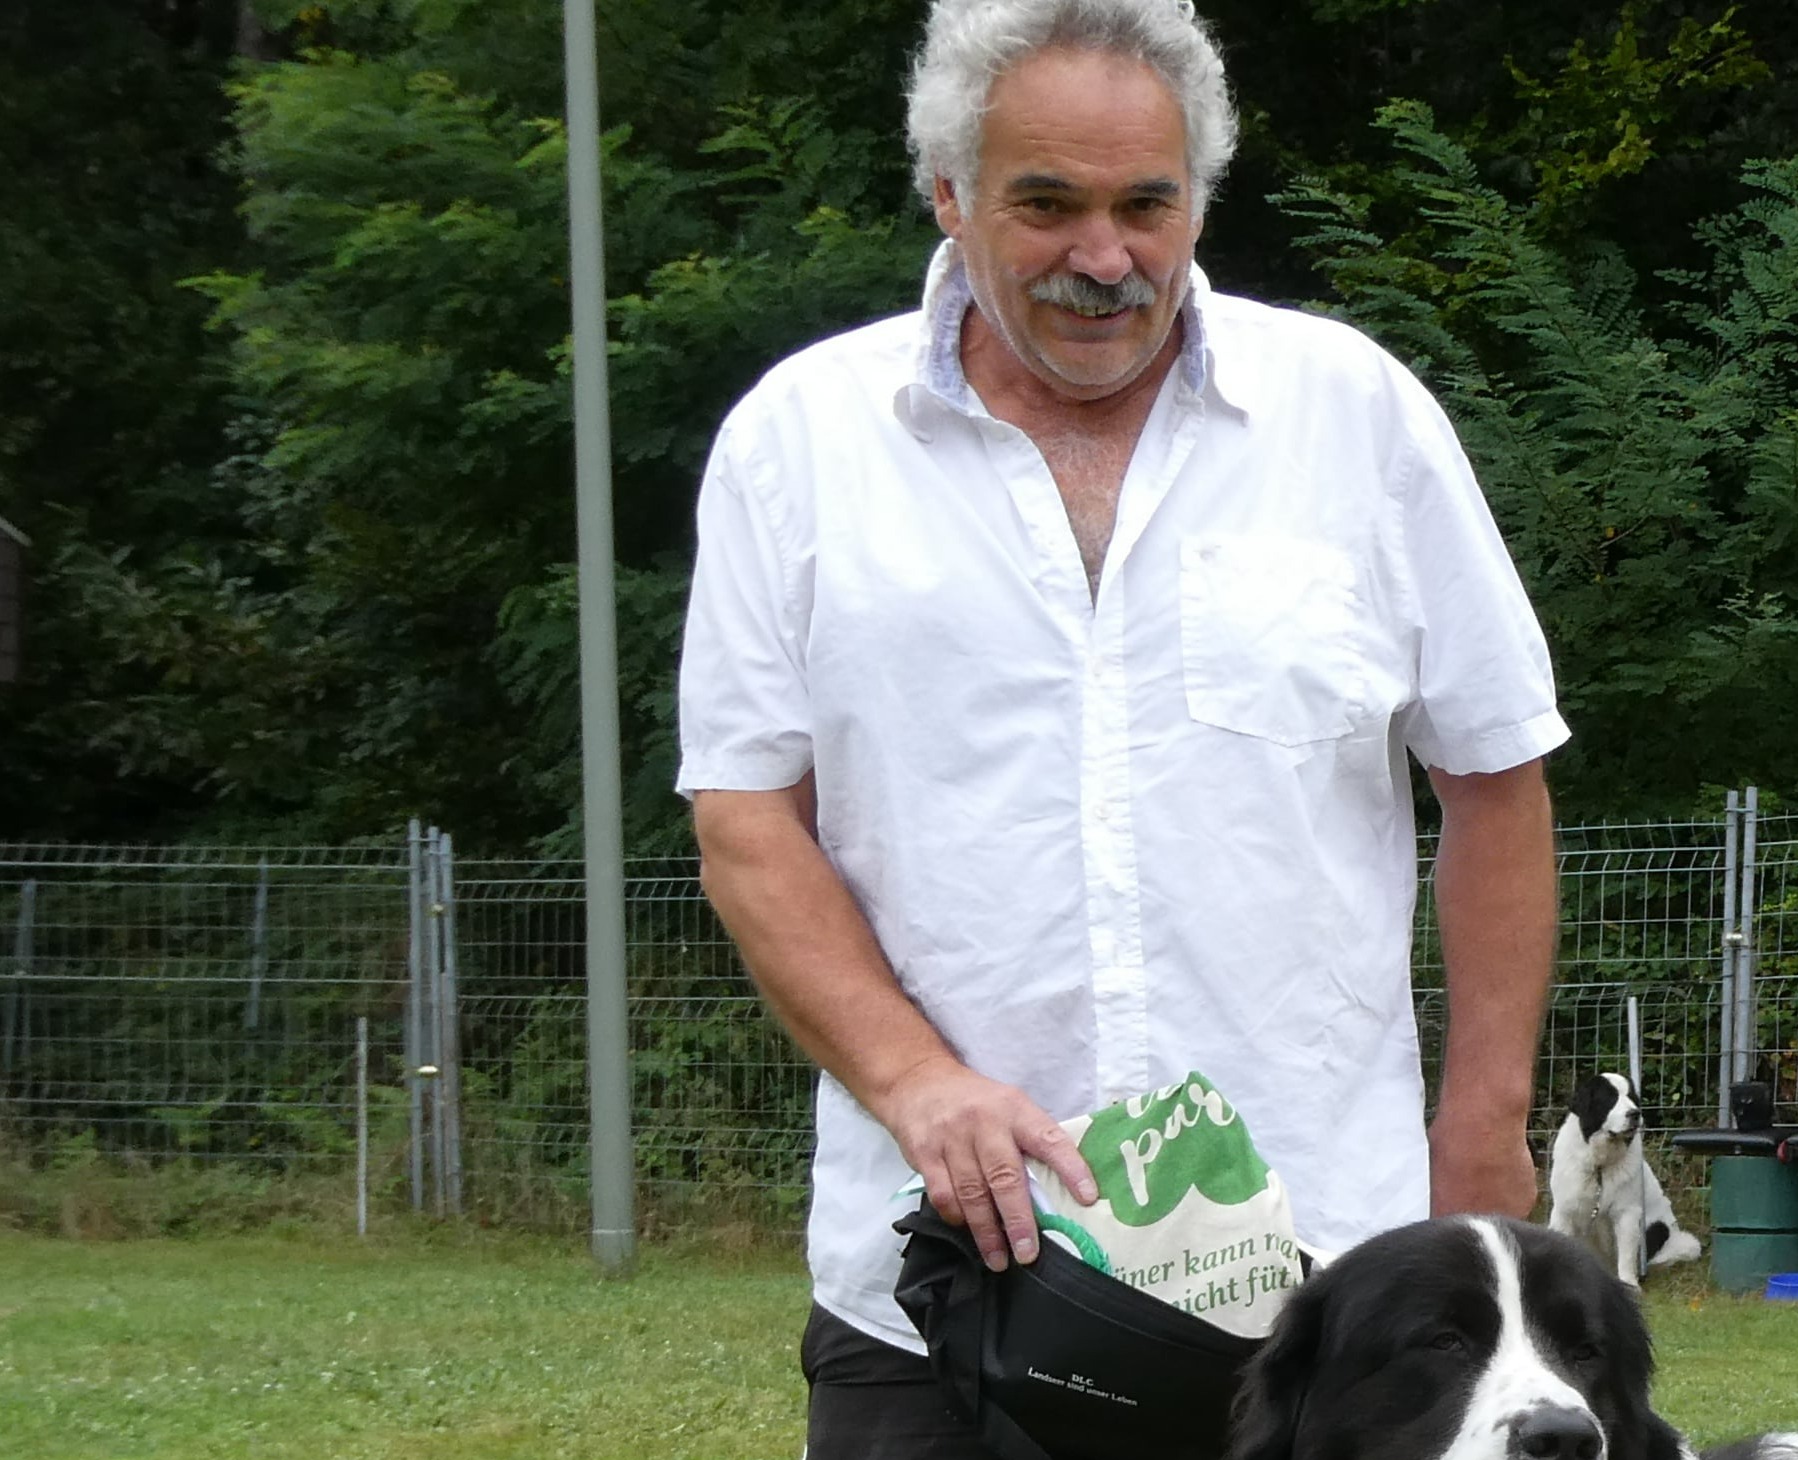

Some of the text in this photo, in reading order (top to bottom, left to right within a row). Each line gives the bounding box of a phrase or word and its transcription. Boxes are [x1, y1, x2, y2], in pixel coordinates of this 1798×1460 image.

[1182, 1237, 1256, 1277] kann
[1171, 1277, 1240, 1315] icht
[1071, 1373, 1095, 1387] DLC
